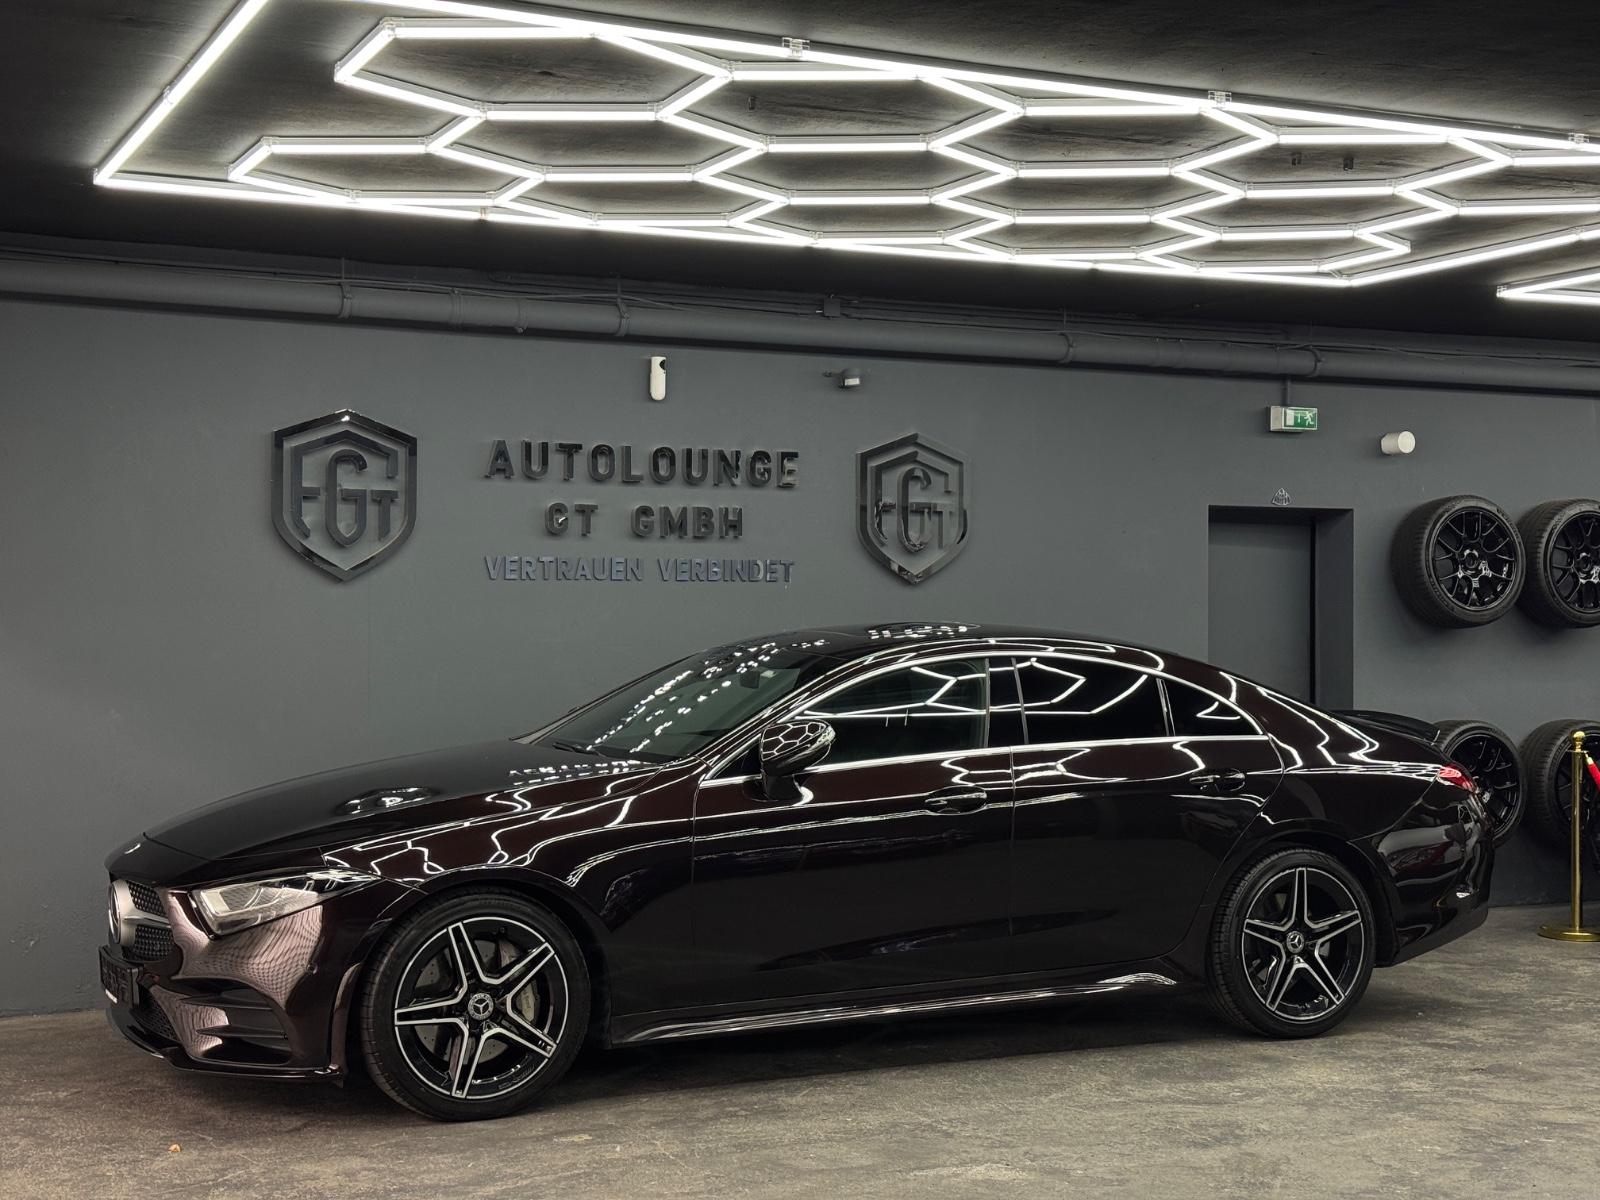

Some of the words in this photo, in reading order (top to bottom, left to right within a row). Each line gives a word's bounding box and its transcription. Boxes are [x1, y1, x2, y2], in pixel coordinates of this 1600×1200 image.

[486, 439, 799, 487] AUTOLOUNGE
[545, 503, 599, 536] GT
[631, 504, 743, 539] GMBH
[484, 555, 644, 581] VERTRAUEN
[657, 558, 795, 583] VERBINDET
